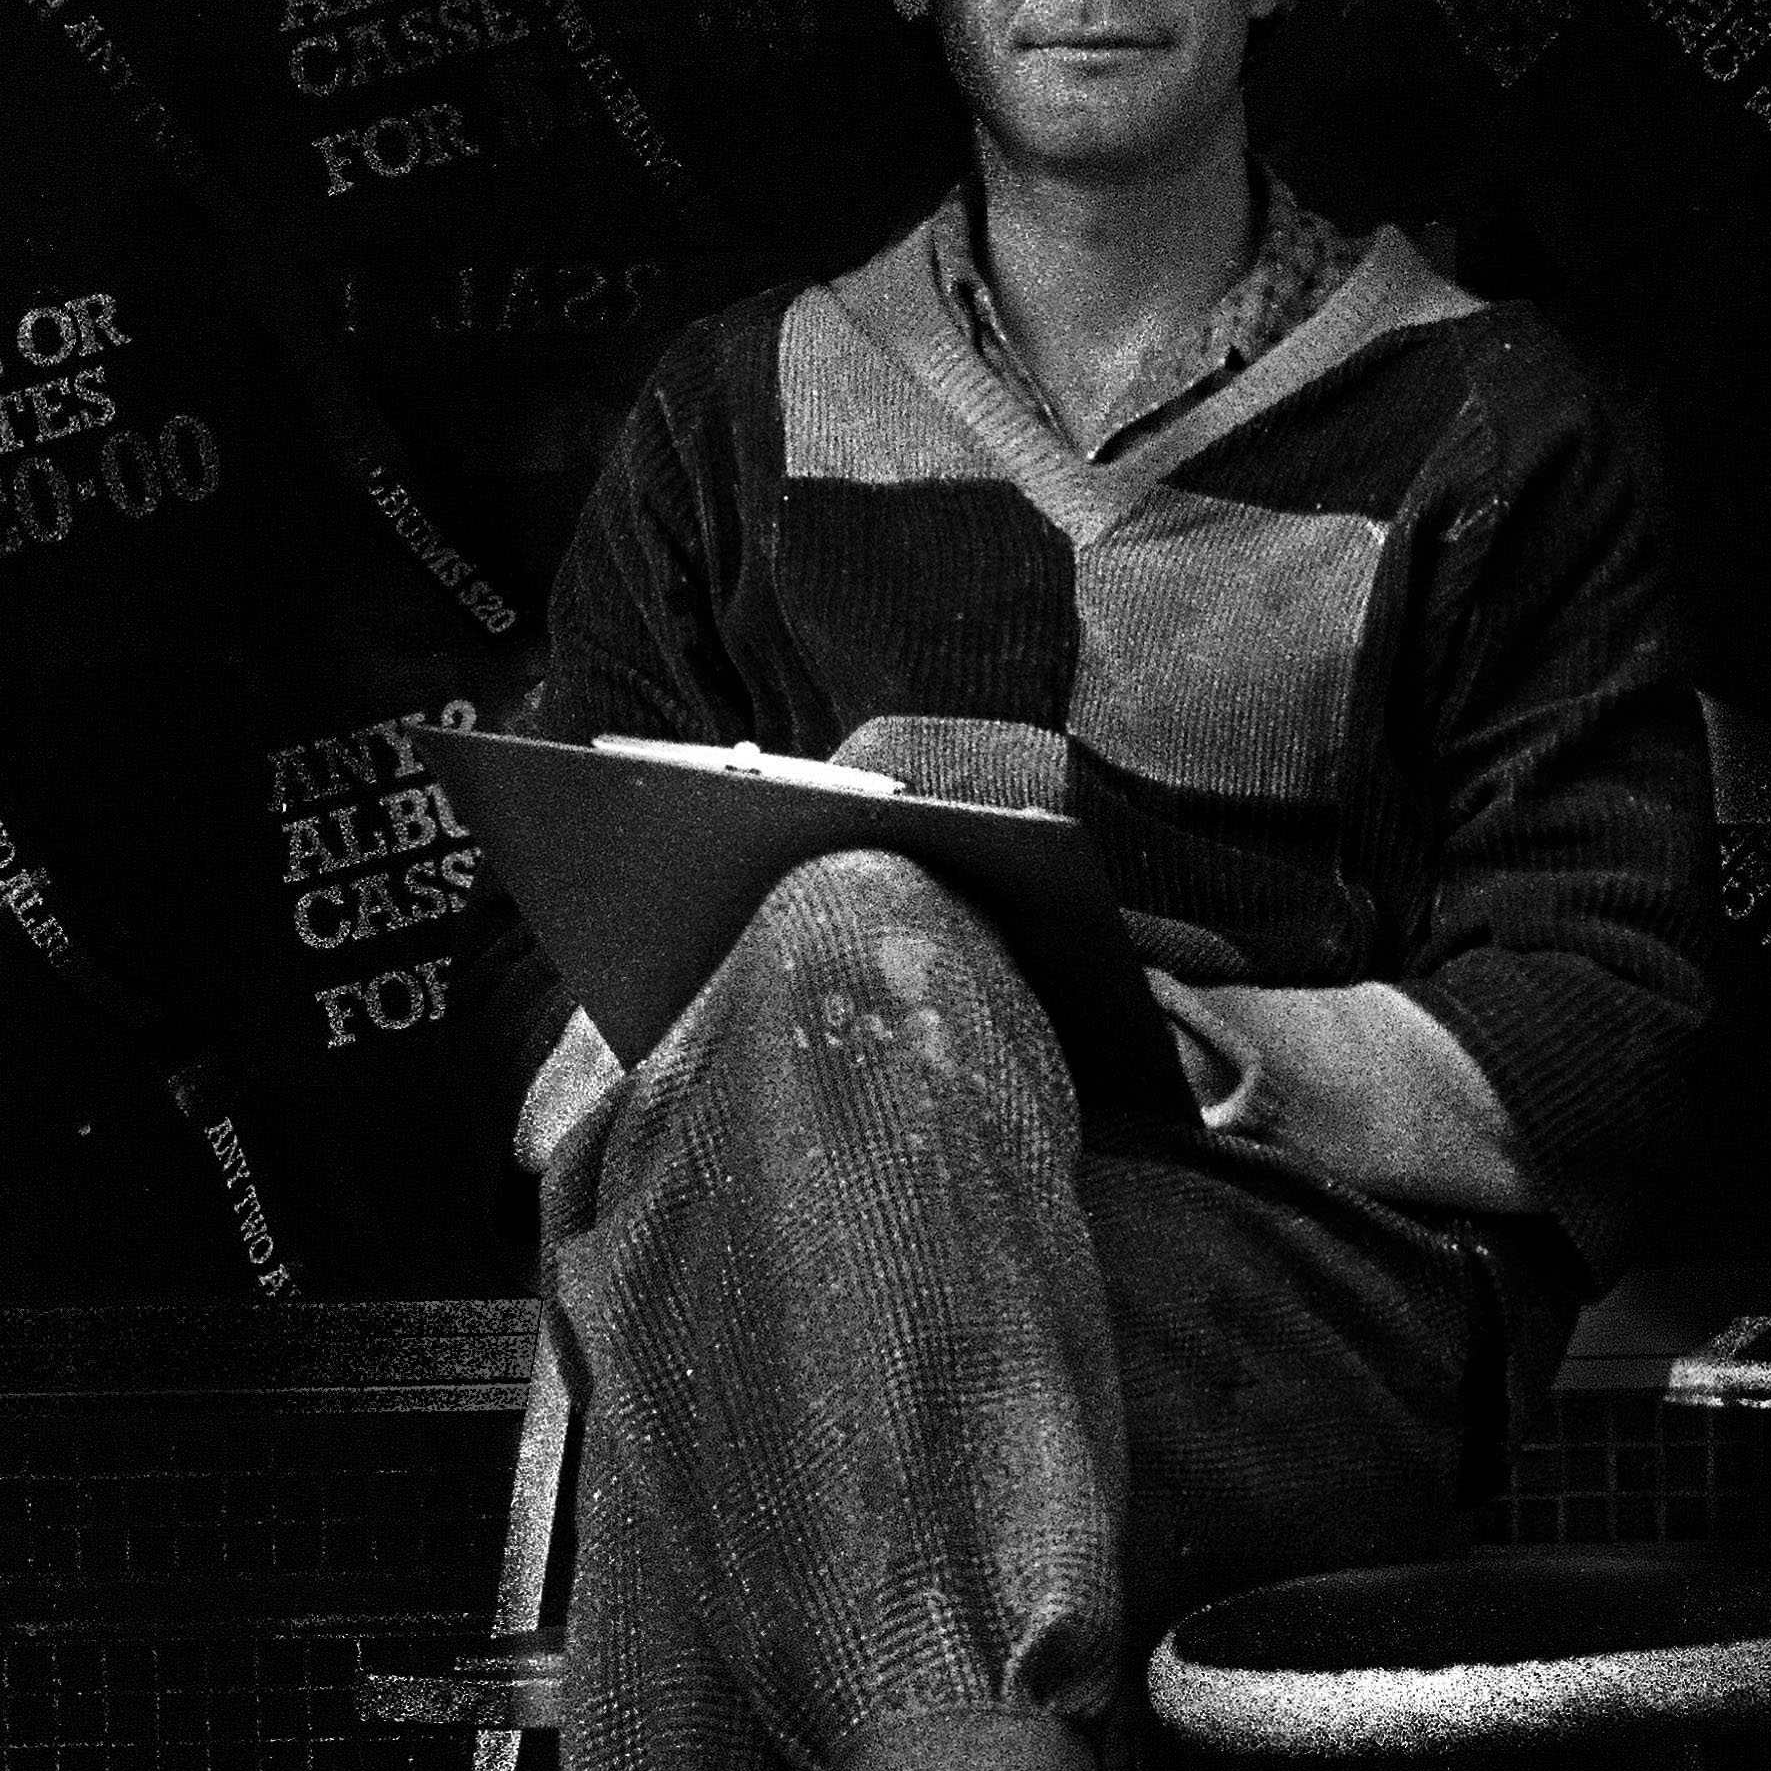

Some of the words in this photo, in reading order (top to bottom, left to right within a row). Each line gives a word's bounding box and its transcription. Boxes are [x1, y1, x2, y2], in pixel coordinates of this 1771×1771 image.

[310, 101, 482, 199] FOR
[15, 289, 134, 368] OR
[266, 711, 427, 815] ANY
[201, 1114, 254, 1190] ANY
[226, 1182, 279, 1270] TWO
